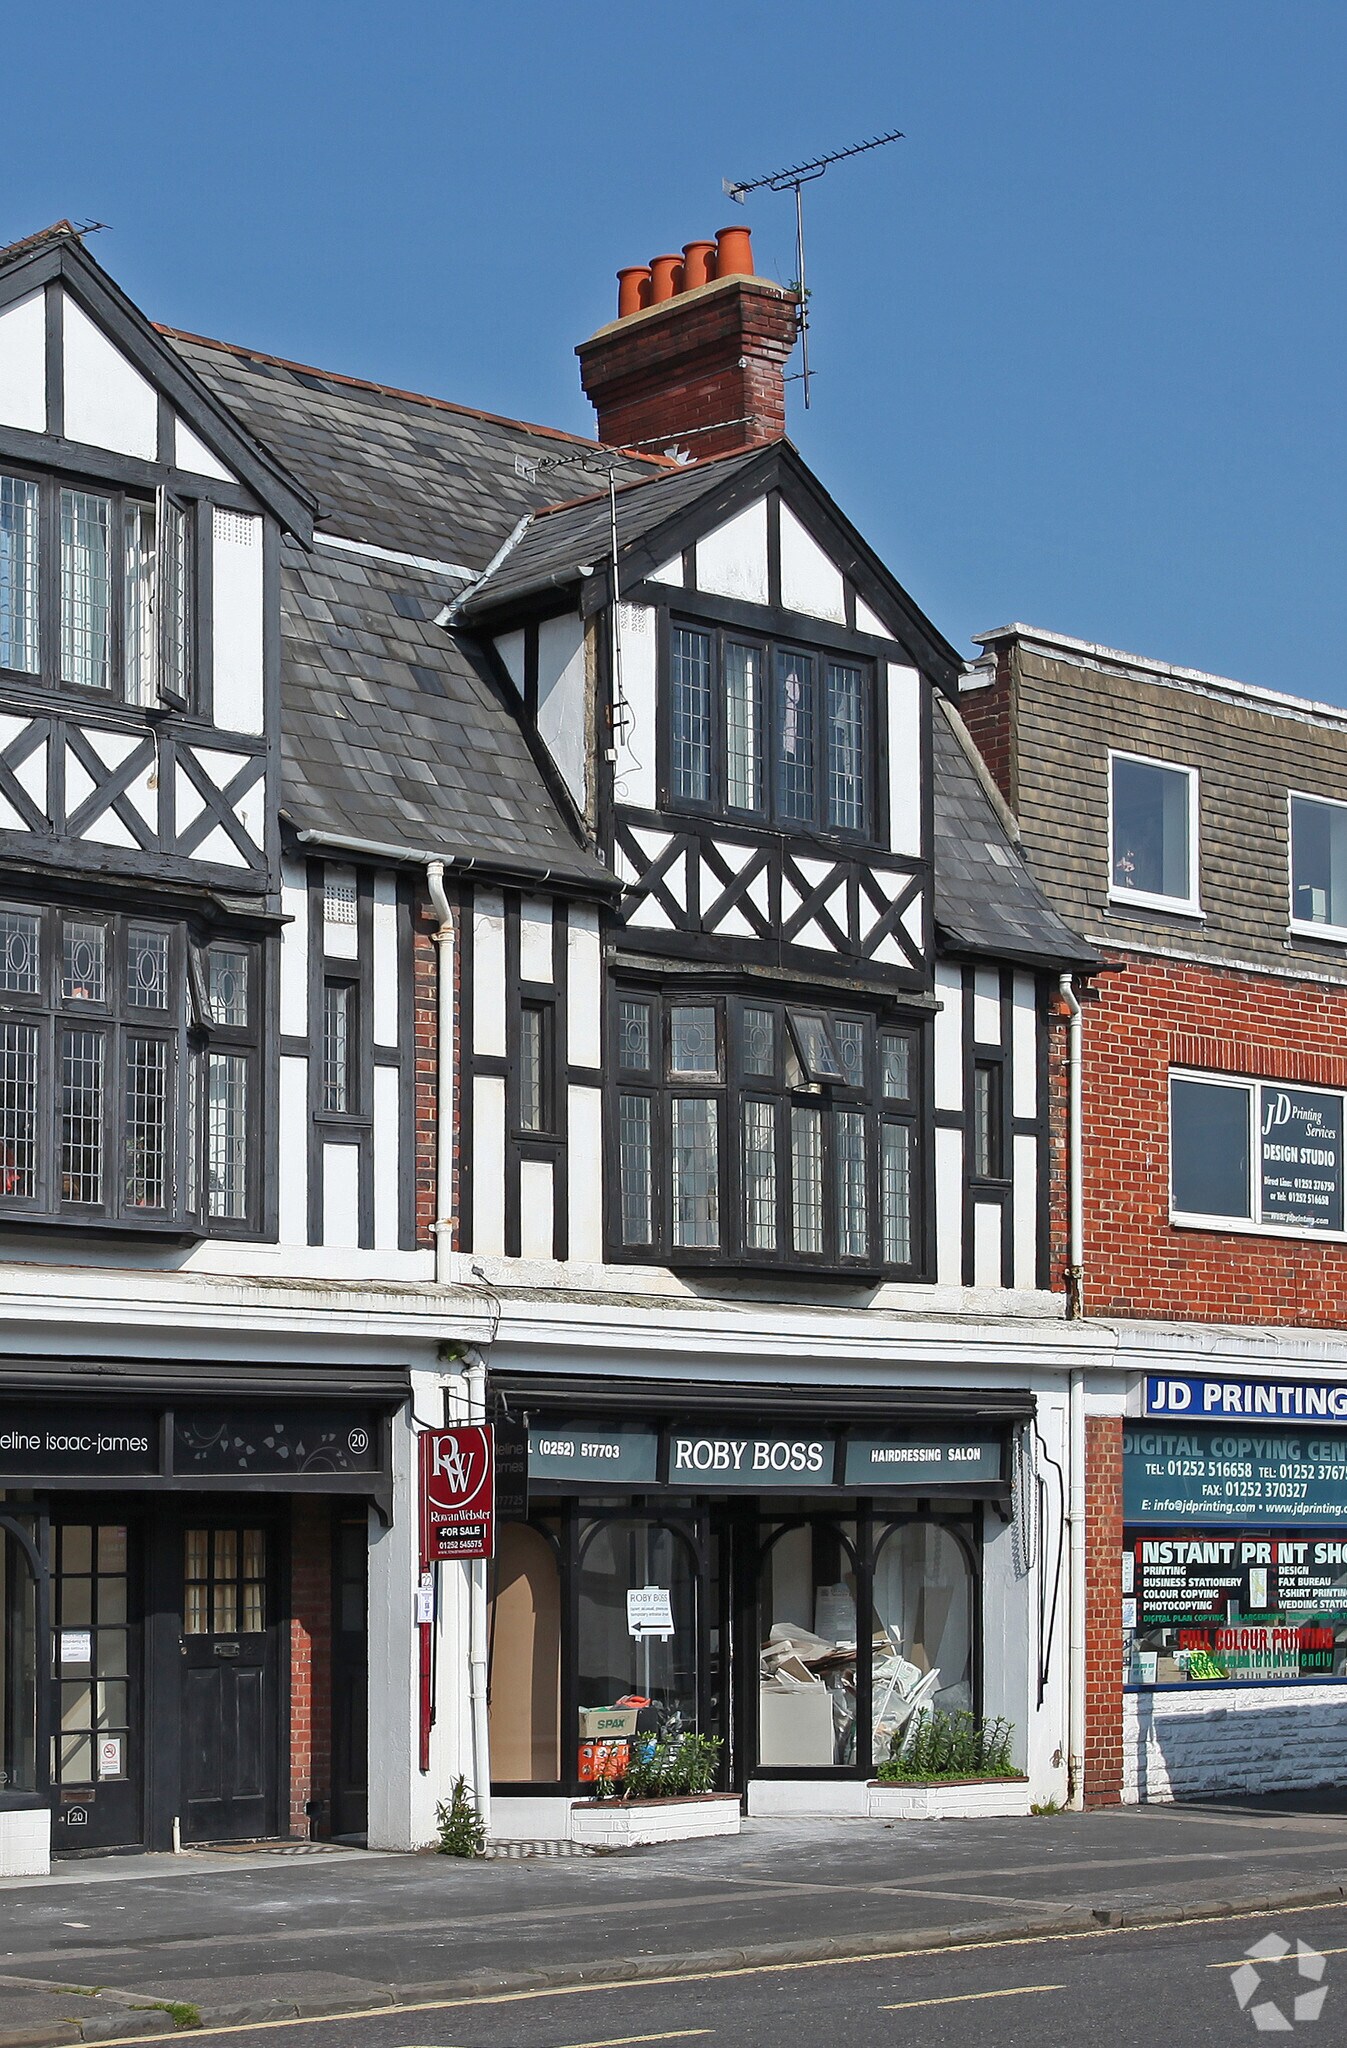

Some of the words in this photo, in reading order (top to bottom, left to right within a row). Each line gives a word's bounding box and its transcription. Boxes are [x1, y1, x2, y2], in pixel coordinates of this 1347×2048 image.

[1262, 1093, 1291, 1135] JD
[1291, 1105, 1322, 1124] Printing
[1306, 1124, 1336, 1140] Services
[1263, 1143, 1298, 1163] DESIGN
[1300, 1147, 1335, 1167] STUDIO
[1294, 1177, 1313, 1190] 01252
[1313, 1179, 1335, 1192] 376750
[1288, 1191, 1307, 1203] 01252
[1307, 1193, 1330, 1206] 516658
[1151, 1381, 1192, 1410] JD
[1203, 1383, 1347, 1415] PRINTING
[0, 1431, 41, 1450] eline
[45, 1431, 148, 1454] isaac-james
[351, 1434, 366, 1448] 20
[539, 1439, 575, 1458] (0252)
[581, 1443, 620, 1458] 517703
[1122, 1433, 1204, 1457] DIGITAL
[1210, 1437, 1301, 1460] COPYING
[1307, 1440, 1347, 1462] CEN
[675, 1440, 747, 1470] ROBY
[752, 1442, 823, 1471] BOSS
[871, 1448, 942, 1462] HAIRDRESSING
[947, 1447, 981, 1461] SALON
[1145, 1463, 1165, 1475] TEL:
[1167, 1460, 1205, 1476] 01252
[1208, 1461, 1253, 1478] 516658
[1258, 1466, 1277, 1479] TEL:
[1279, 1463, 1315, 1480] 01252
[1317, 1465, 1347, 1481] 3767
[1202, 1484, 1223, 1496] FAX:
[1225, 1481, 1262, 1497] 01252
[1265, 1483, 1308, 1499] 370327
[1141, 1499, 1152, 1511] E:
[1153, 1499, 1256, 1514] info@jdprinting.com
[459, 1525, 481, 1536] SALE
[439, 1541, 458, 1550] 01252
[459, 1539, 483, 1549] 545575
[1136, 1541, 1235, 1564] INSTANT
[1241, 1542, 1309, 1564] PRINT
[1143, 1566, 1187, 1576] PRINTING
[1278, 1566, 1309, 1576] DESIGN
[1143, 1577, 1187, 1588] BUSINESS
[1188, 1577, 1243, 1588] STATIONERY
[1278, 1577, 1296, 1587] FAX
[1297, 1576, 1332, 1587] BUREAU
[630, 1593, 652, 1603] ROBY
[1143, 1589, 1179, 1599] COLOUR
[1180, 1589, 1219, 1599] COPYING
[1278, 1588, 1311, 1598] T-SHIRT
[1312, 1588, 1347, 1598] PRINTIN
[1143, 1600, 1213, 1611] PHOTOCOPYING
[1278, 1599, 1318, 1609] WEDDING
[1143, 1614, 1171, 1623] DIGITAL
[1172, 1614, 1193, 1623] PLAN
[1194, 1614, 1225, 1622] COPYING
[1214, 1629, 1269, 1651] COLOUR
[1272, 1627, 1335, 1650] PRINTING
[597, 1719, 625, 1730] SPAX
[71, 1812, 83, 1822] 20
